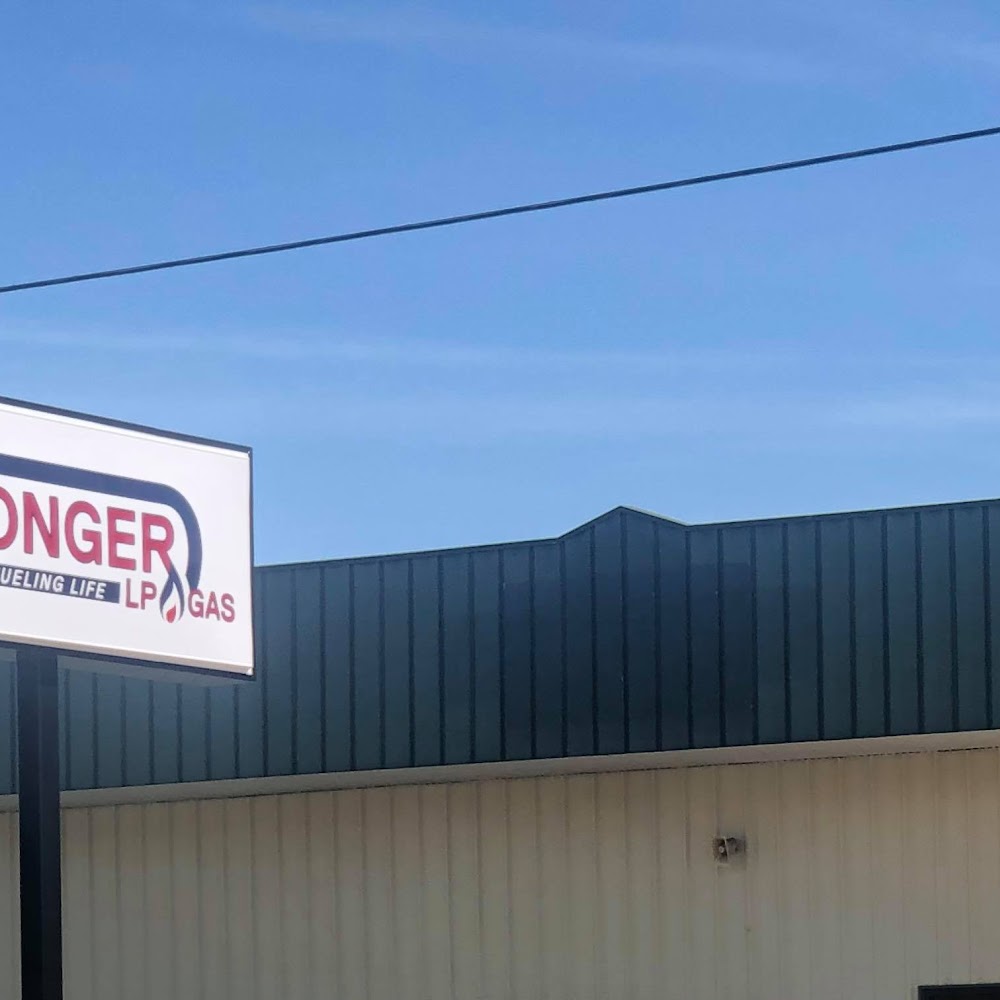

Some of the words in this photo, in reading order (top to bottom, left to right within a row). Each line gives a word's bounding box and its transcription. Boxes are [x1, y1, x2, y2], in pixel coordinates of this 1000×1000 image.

[0, 566, 65, 593] UELING
[70, 578, 107, 600] LIFE
[125, 578, 157, 610] LP
[187, 588, 236, 623] GAS
